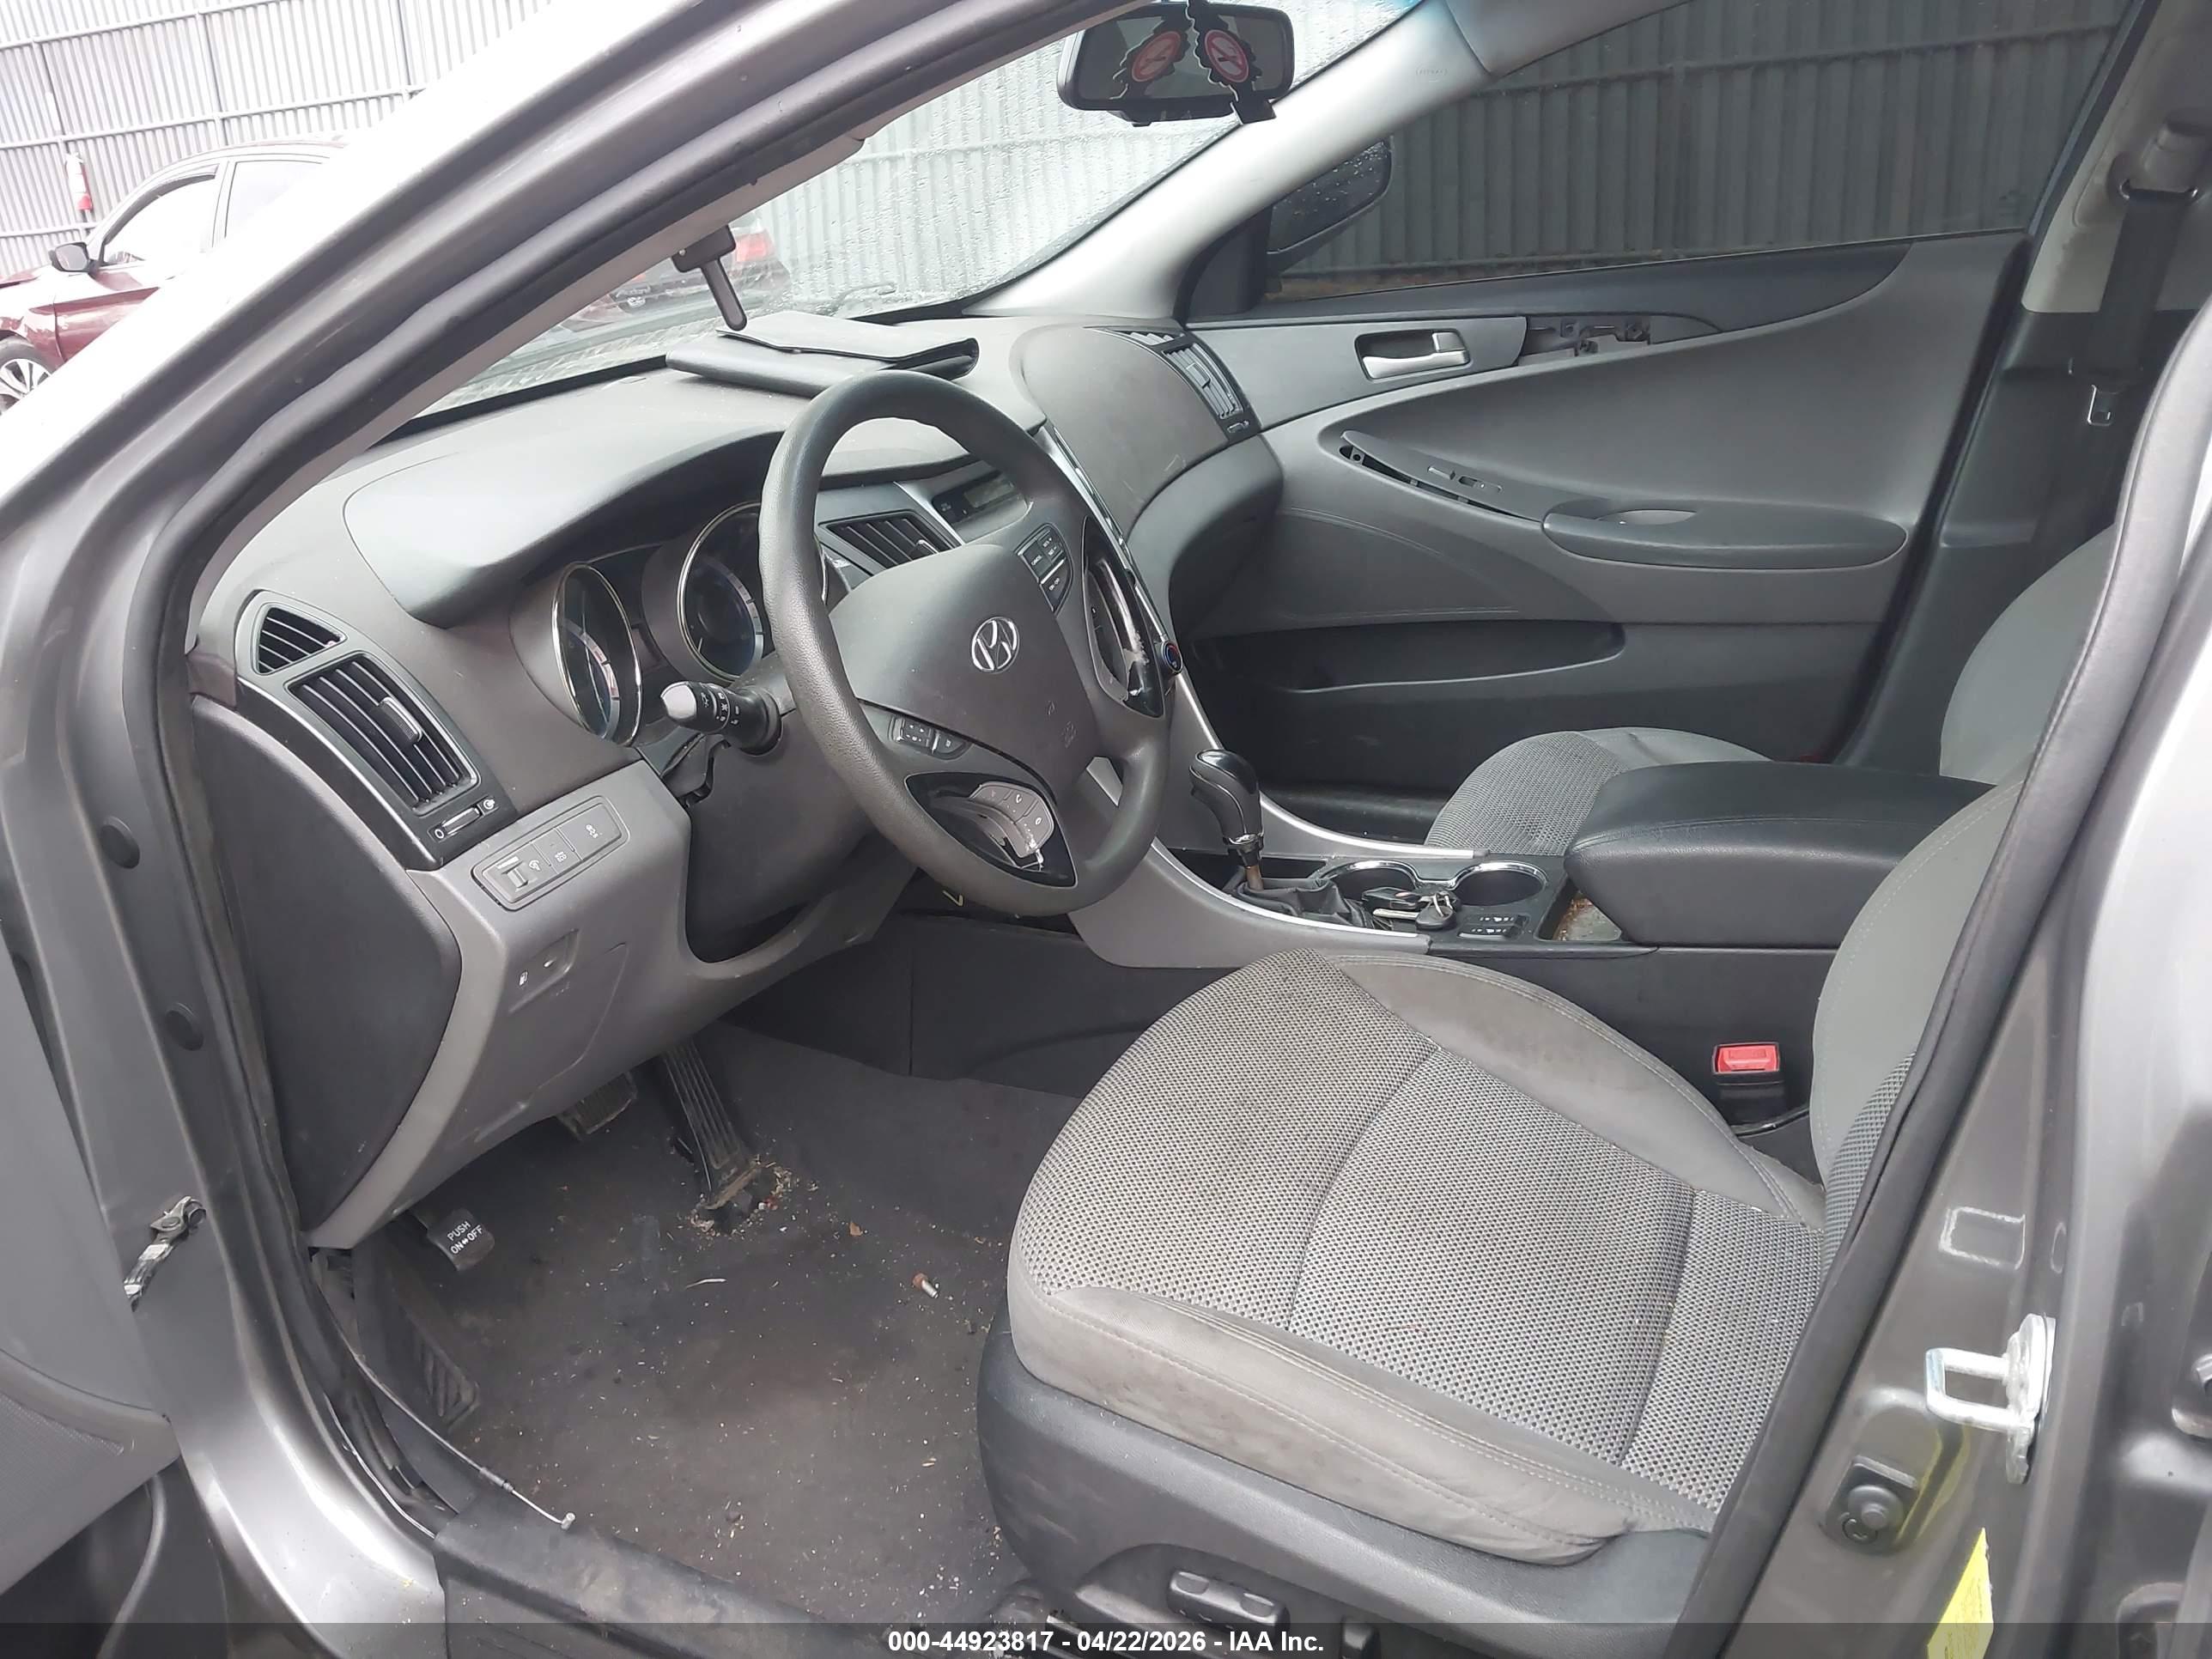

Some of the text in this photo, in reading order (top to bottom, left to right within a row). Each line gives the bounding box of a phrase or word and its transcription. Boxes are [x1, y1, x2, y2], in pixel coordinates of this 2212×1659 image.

[447, 1221, 471, 1241] PUSH
[450, 1224, 483, 1255] ON OFF
